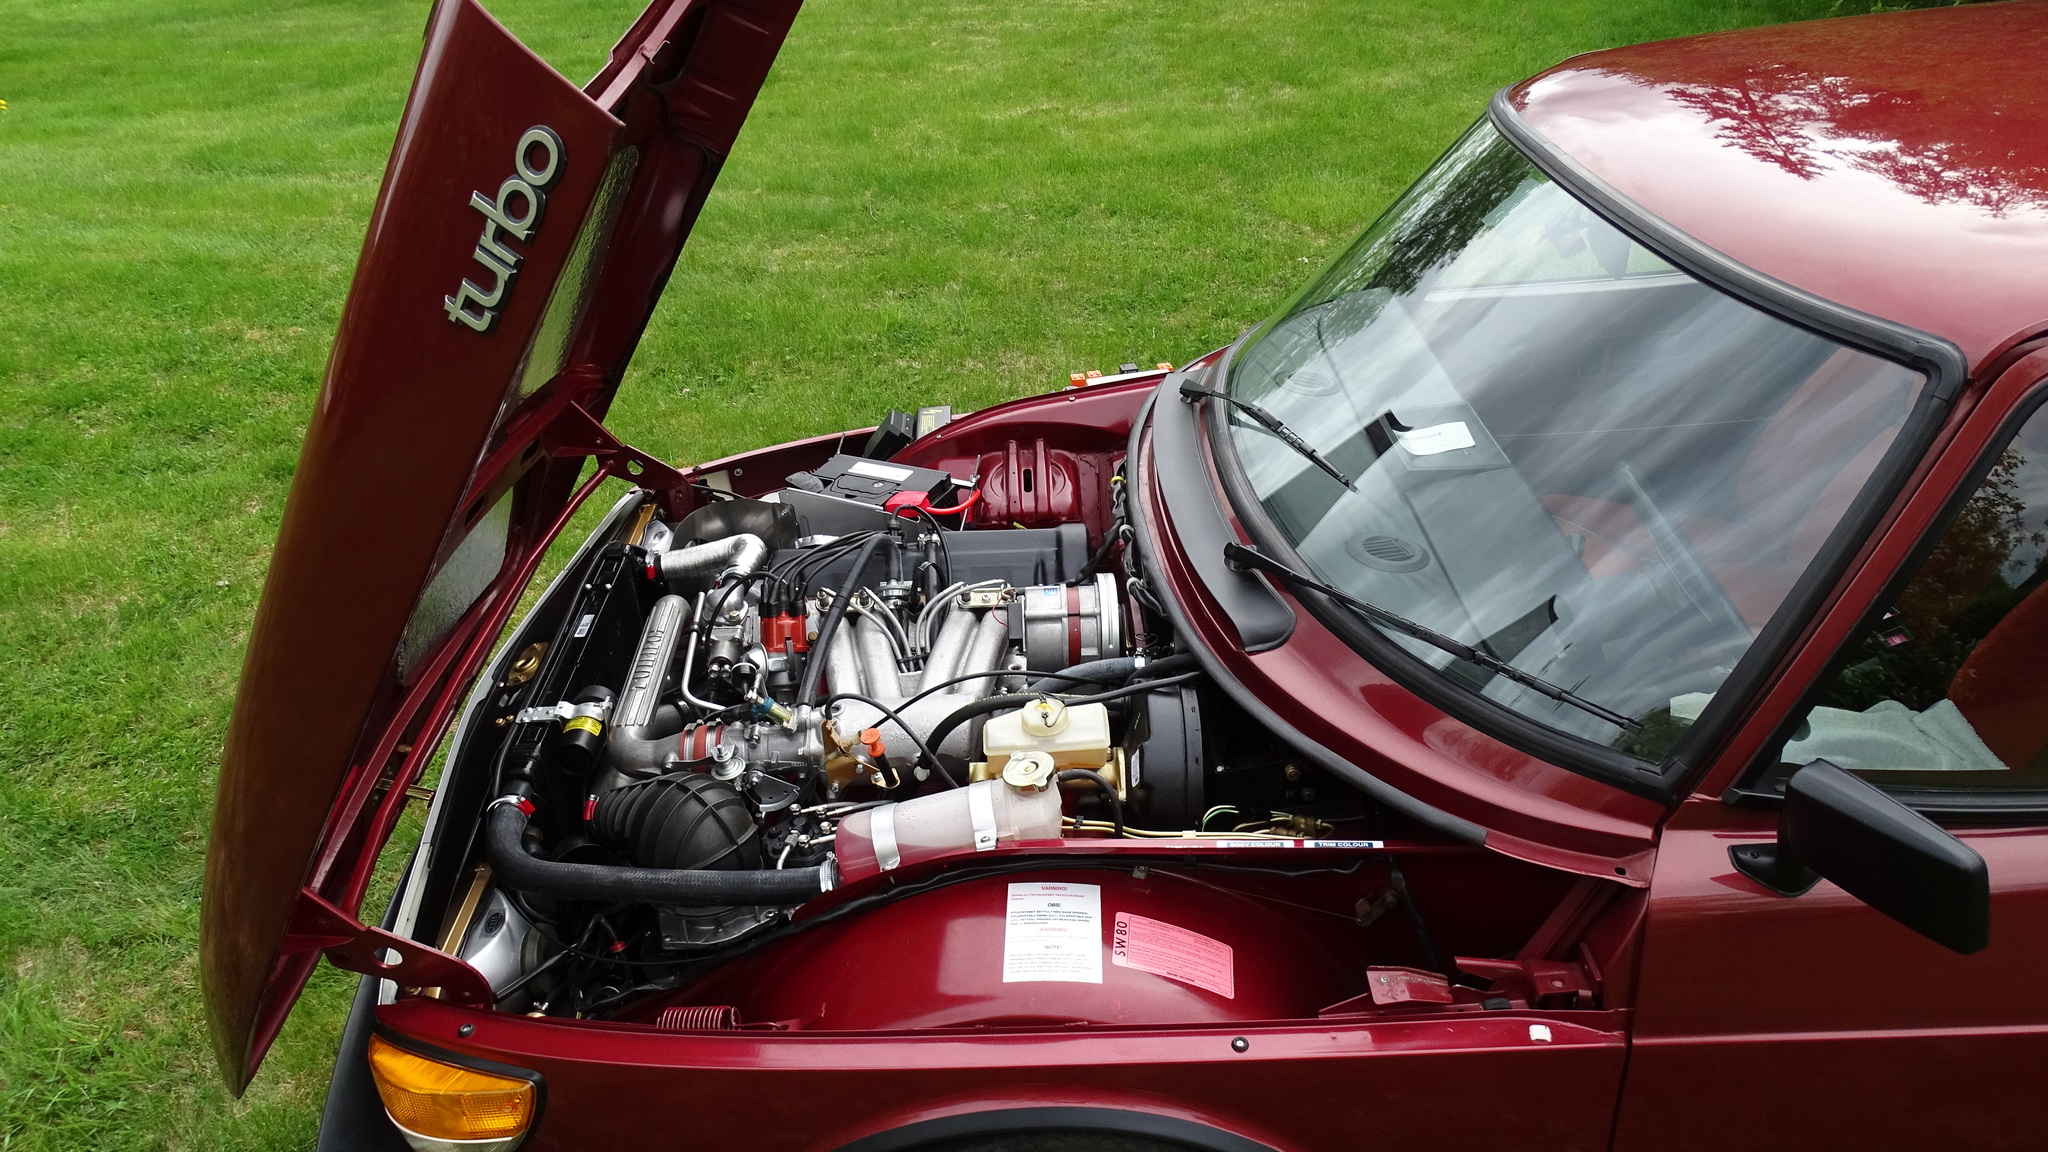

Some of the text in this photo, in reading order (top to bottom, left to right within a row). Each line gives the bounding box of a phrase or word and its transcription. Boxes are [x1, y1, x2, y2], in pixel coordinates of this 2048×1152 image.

[444, 125, 566, 334] turbo
[1114, 921, 1127, 957] SW 80
